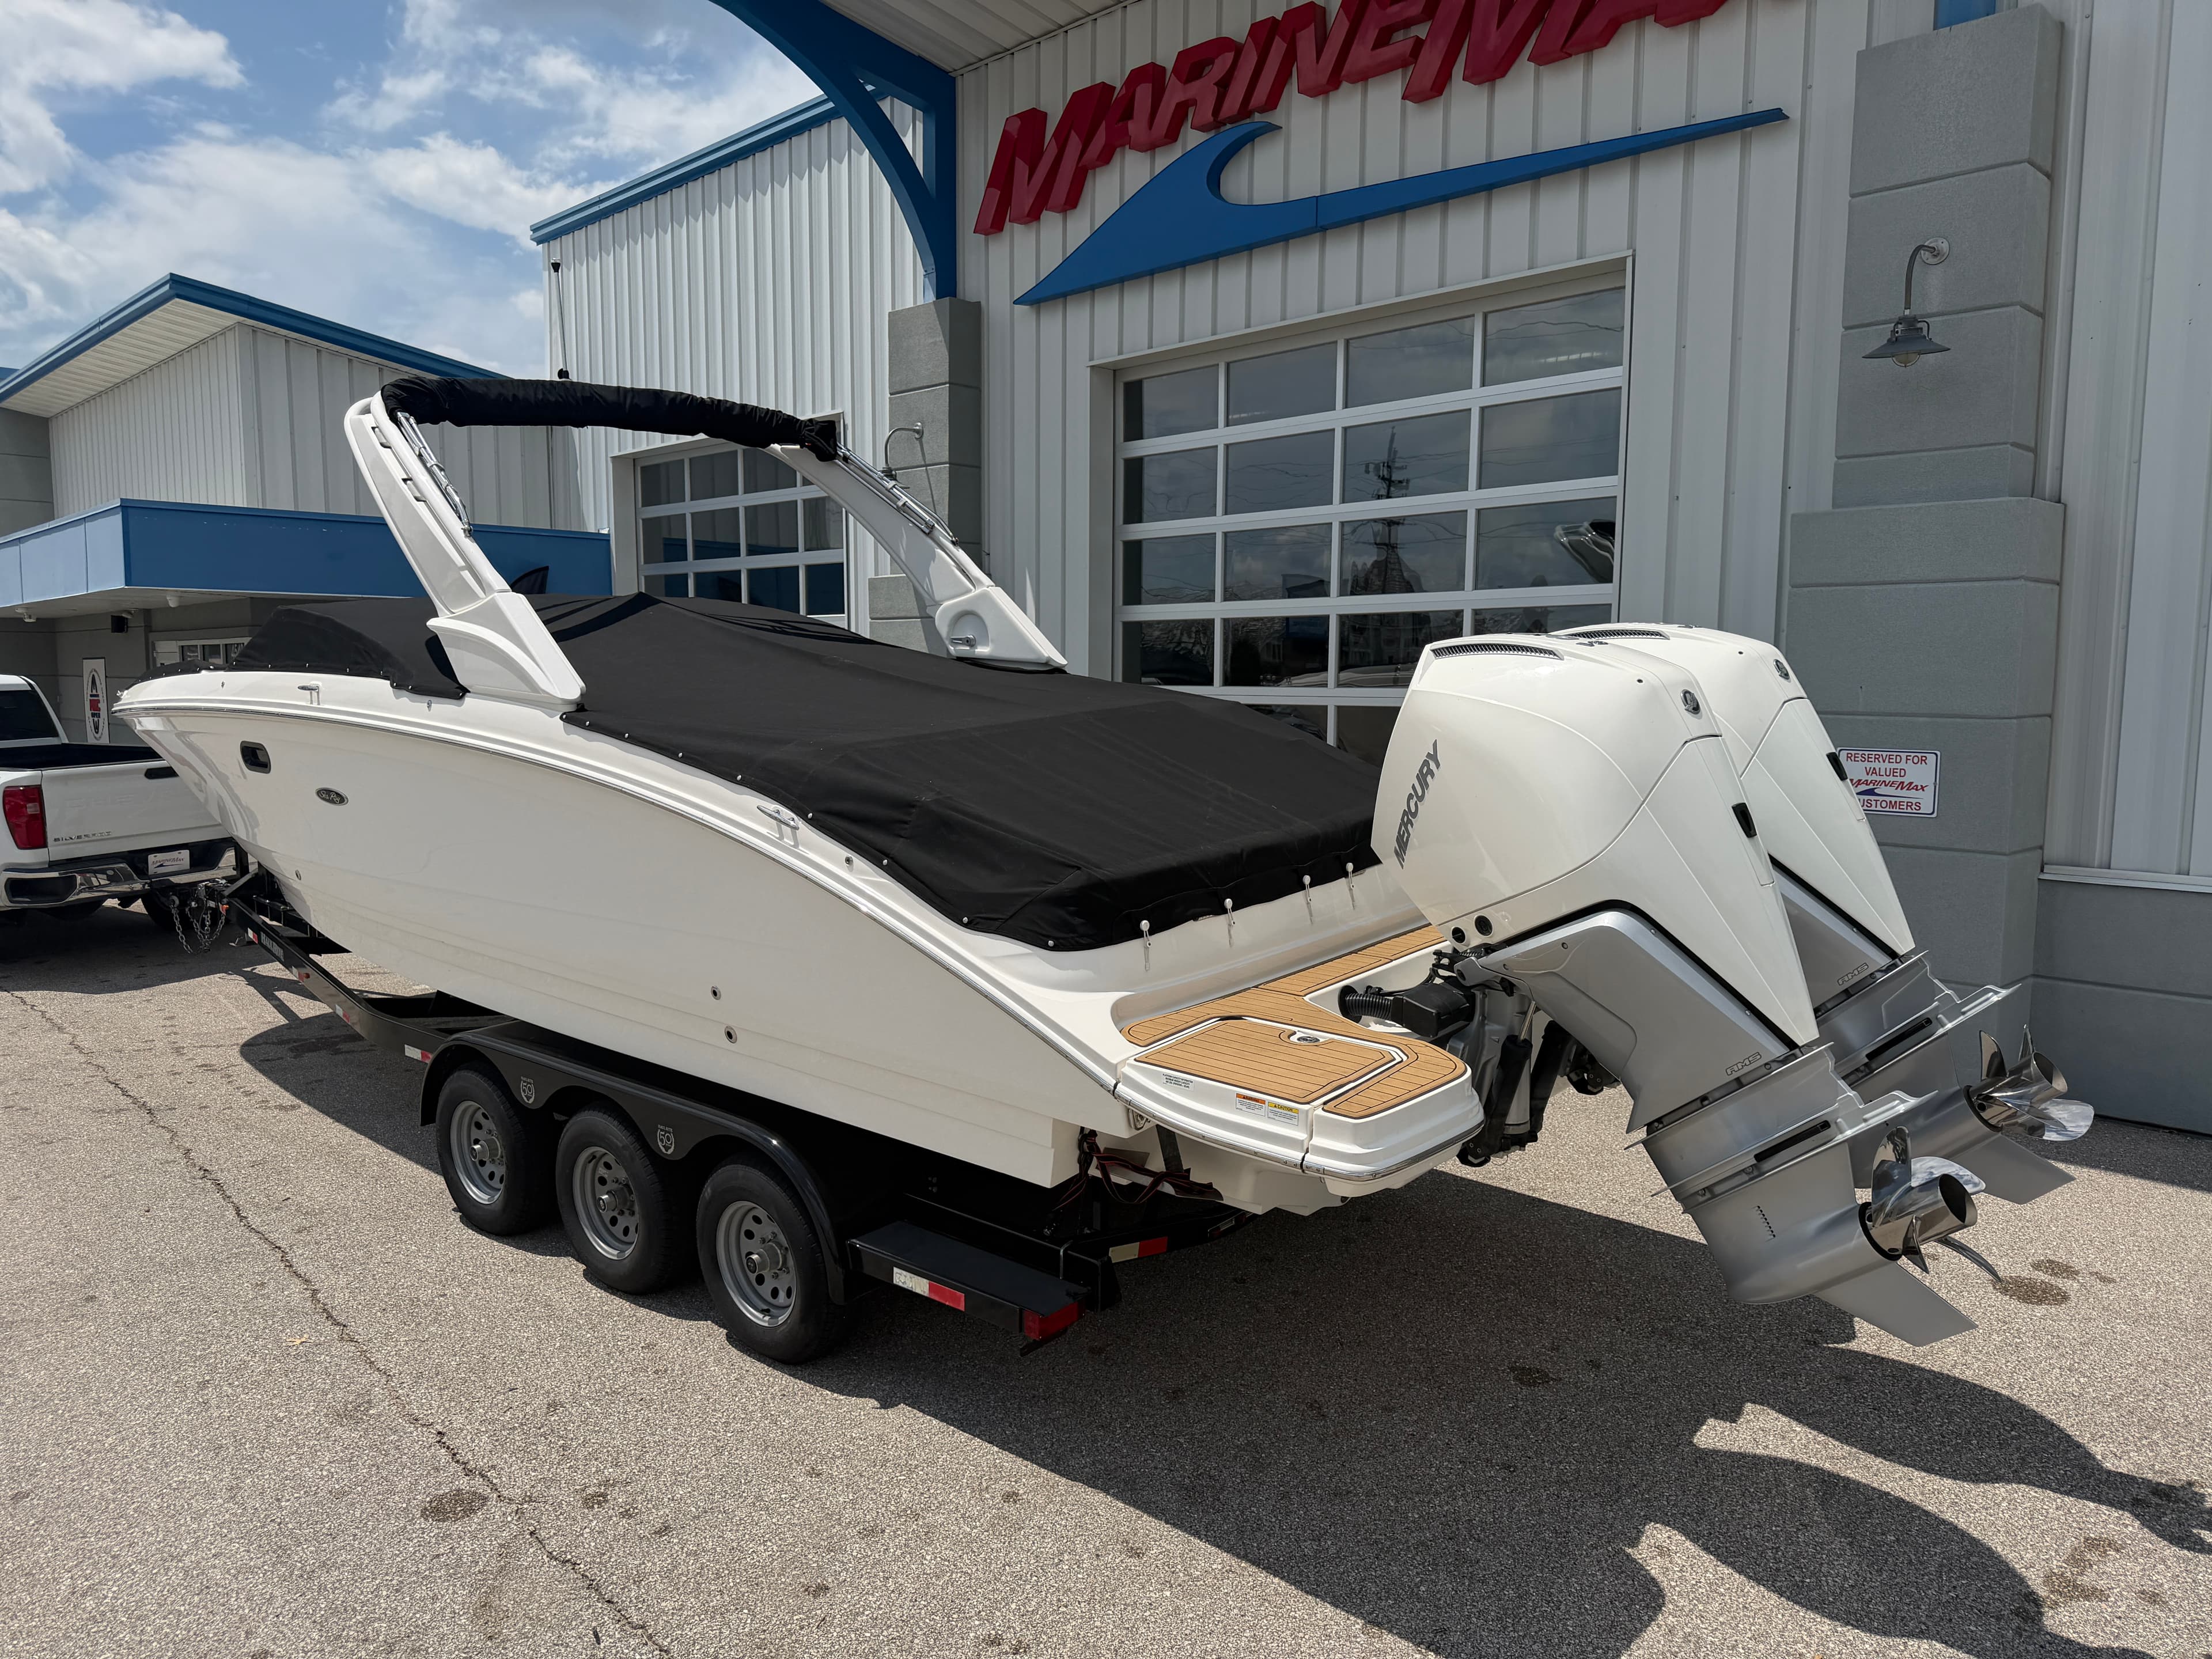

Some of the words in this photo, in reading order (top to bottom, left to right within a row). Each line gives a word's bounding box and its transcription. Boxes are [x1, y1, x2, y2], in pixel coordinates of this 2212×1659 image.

[1846, 752, 1902, 763] RESERVED
[1906, 755, 1927, 765] FOR
[1865, 767, 1906, 778] VALUED
[1393, 738, 1441, 870] MERCURY
[1860, 798, 1922, 811] USTOMERS
[1837, 962, 1869, 986] AMS
[1725, 1051, 1762, 1076] AMS
[522, 1082, 533, 1096] 50
[660, 1131, 672, 1146] 50
